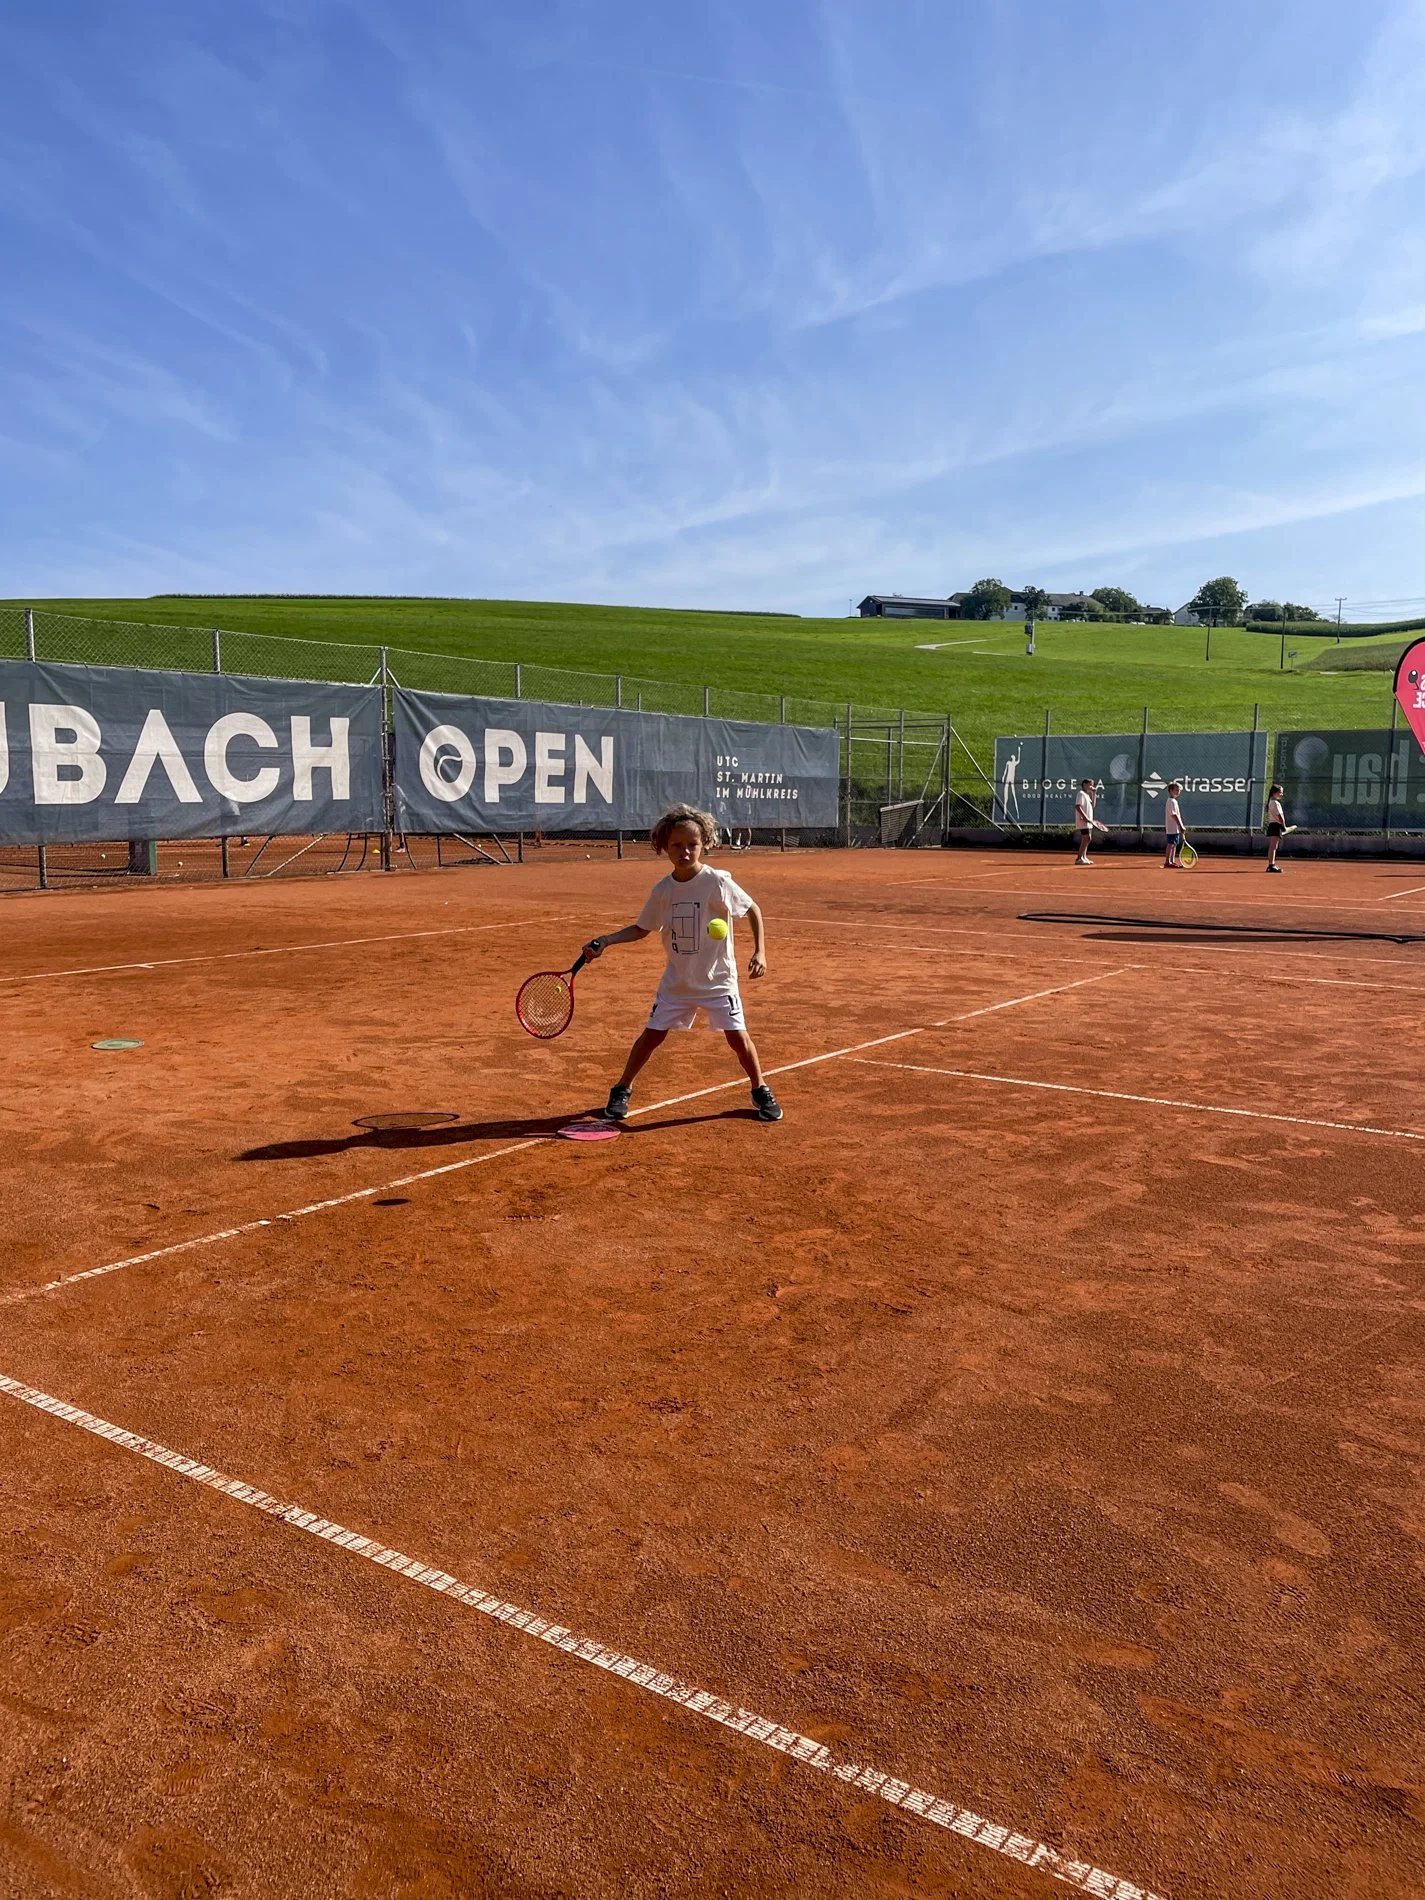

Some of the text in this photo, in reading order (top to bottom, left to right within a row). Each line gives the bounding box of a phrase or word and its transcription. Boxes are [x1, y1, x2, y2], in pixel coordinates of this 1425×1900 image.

[419, 724, 614, 804] OPEN
[716, 755, 739, 768] UTC
[716, 771, 783, 784] ST. MARTIN
[1173, 775, 1256, 793] strasser
[1022, 779, 1105, 790] BIOGEA
[716, 785, 799, 799] IM MÜHLKREIS
